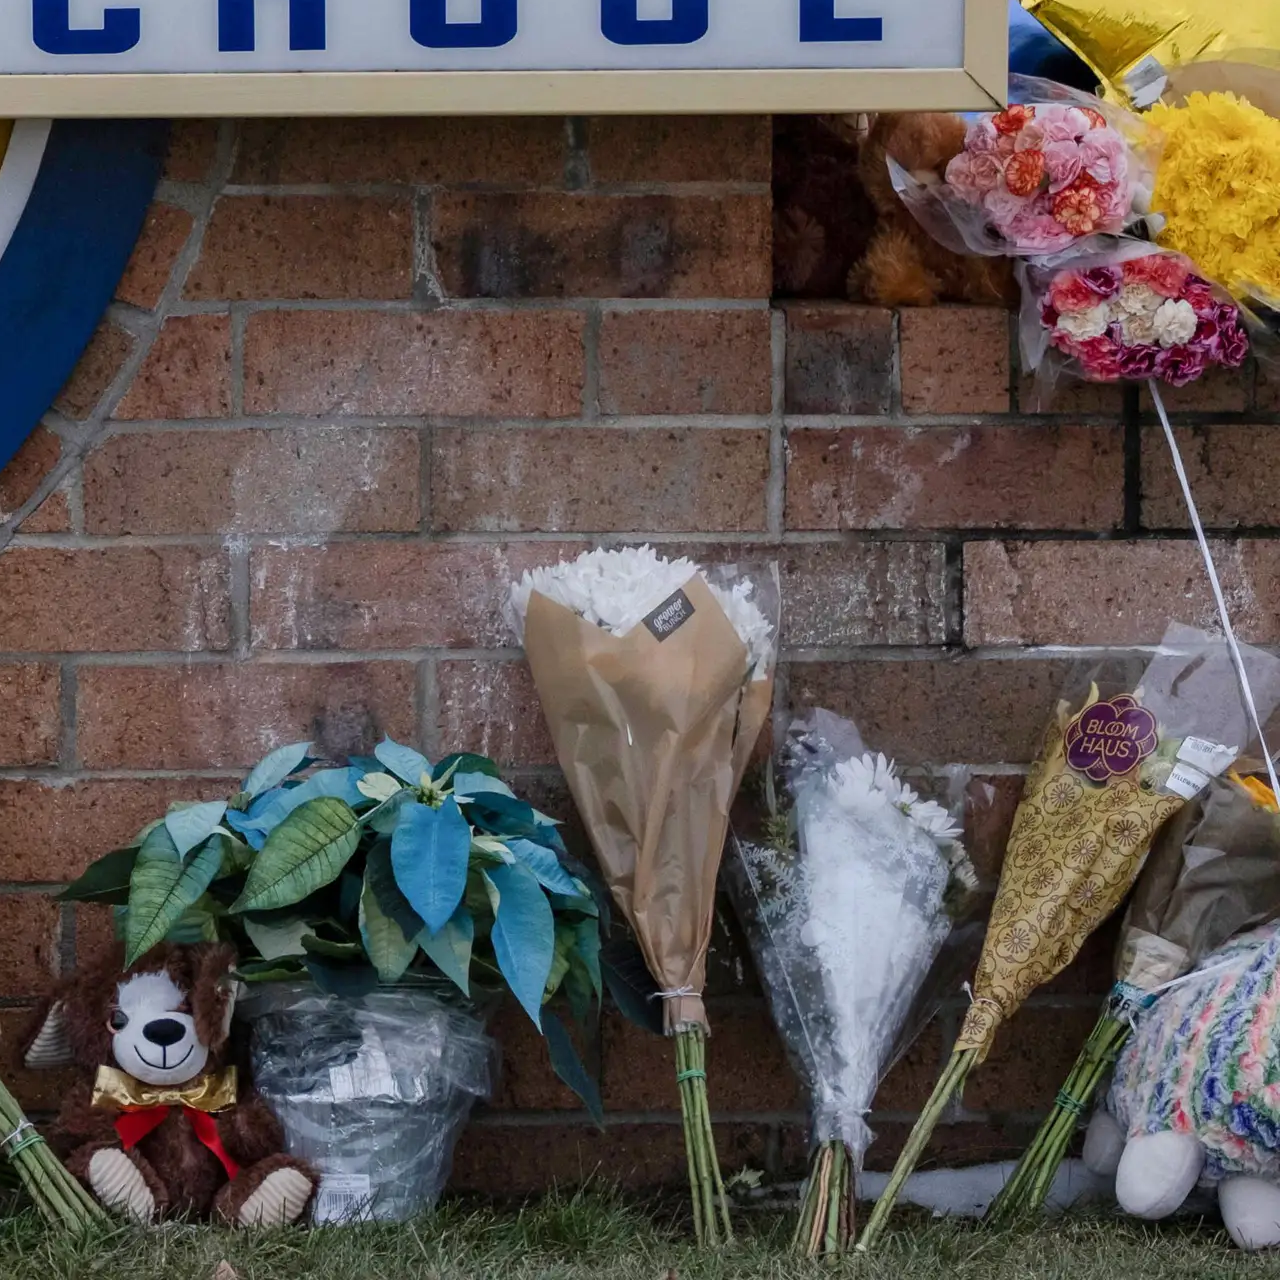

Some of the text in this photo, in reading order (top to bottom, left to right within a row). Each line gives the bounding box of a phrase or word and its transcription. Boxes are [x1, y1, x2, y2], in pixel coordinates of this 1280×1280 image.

[653, 598, 682, 633] grower
[662, 609, 686, 632] BUNCH
[1086, 719, 1140, 740] BLOOM
[1079, 736, 1132, 757] HAUS
